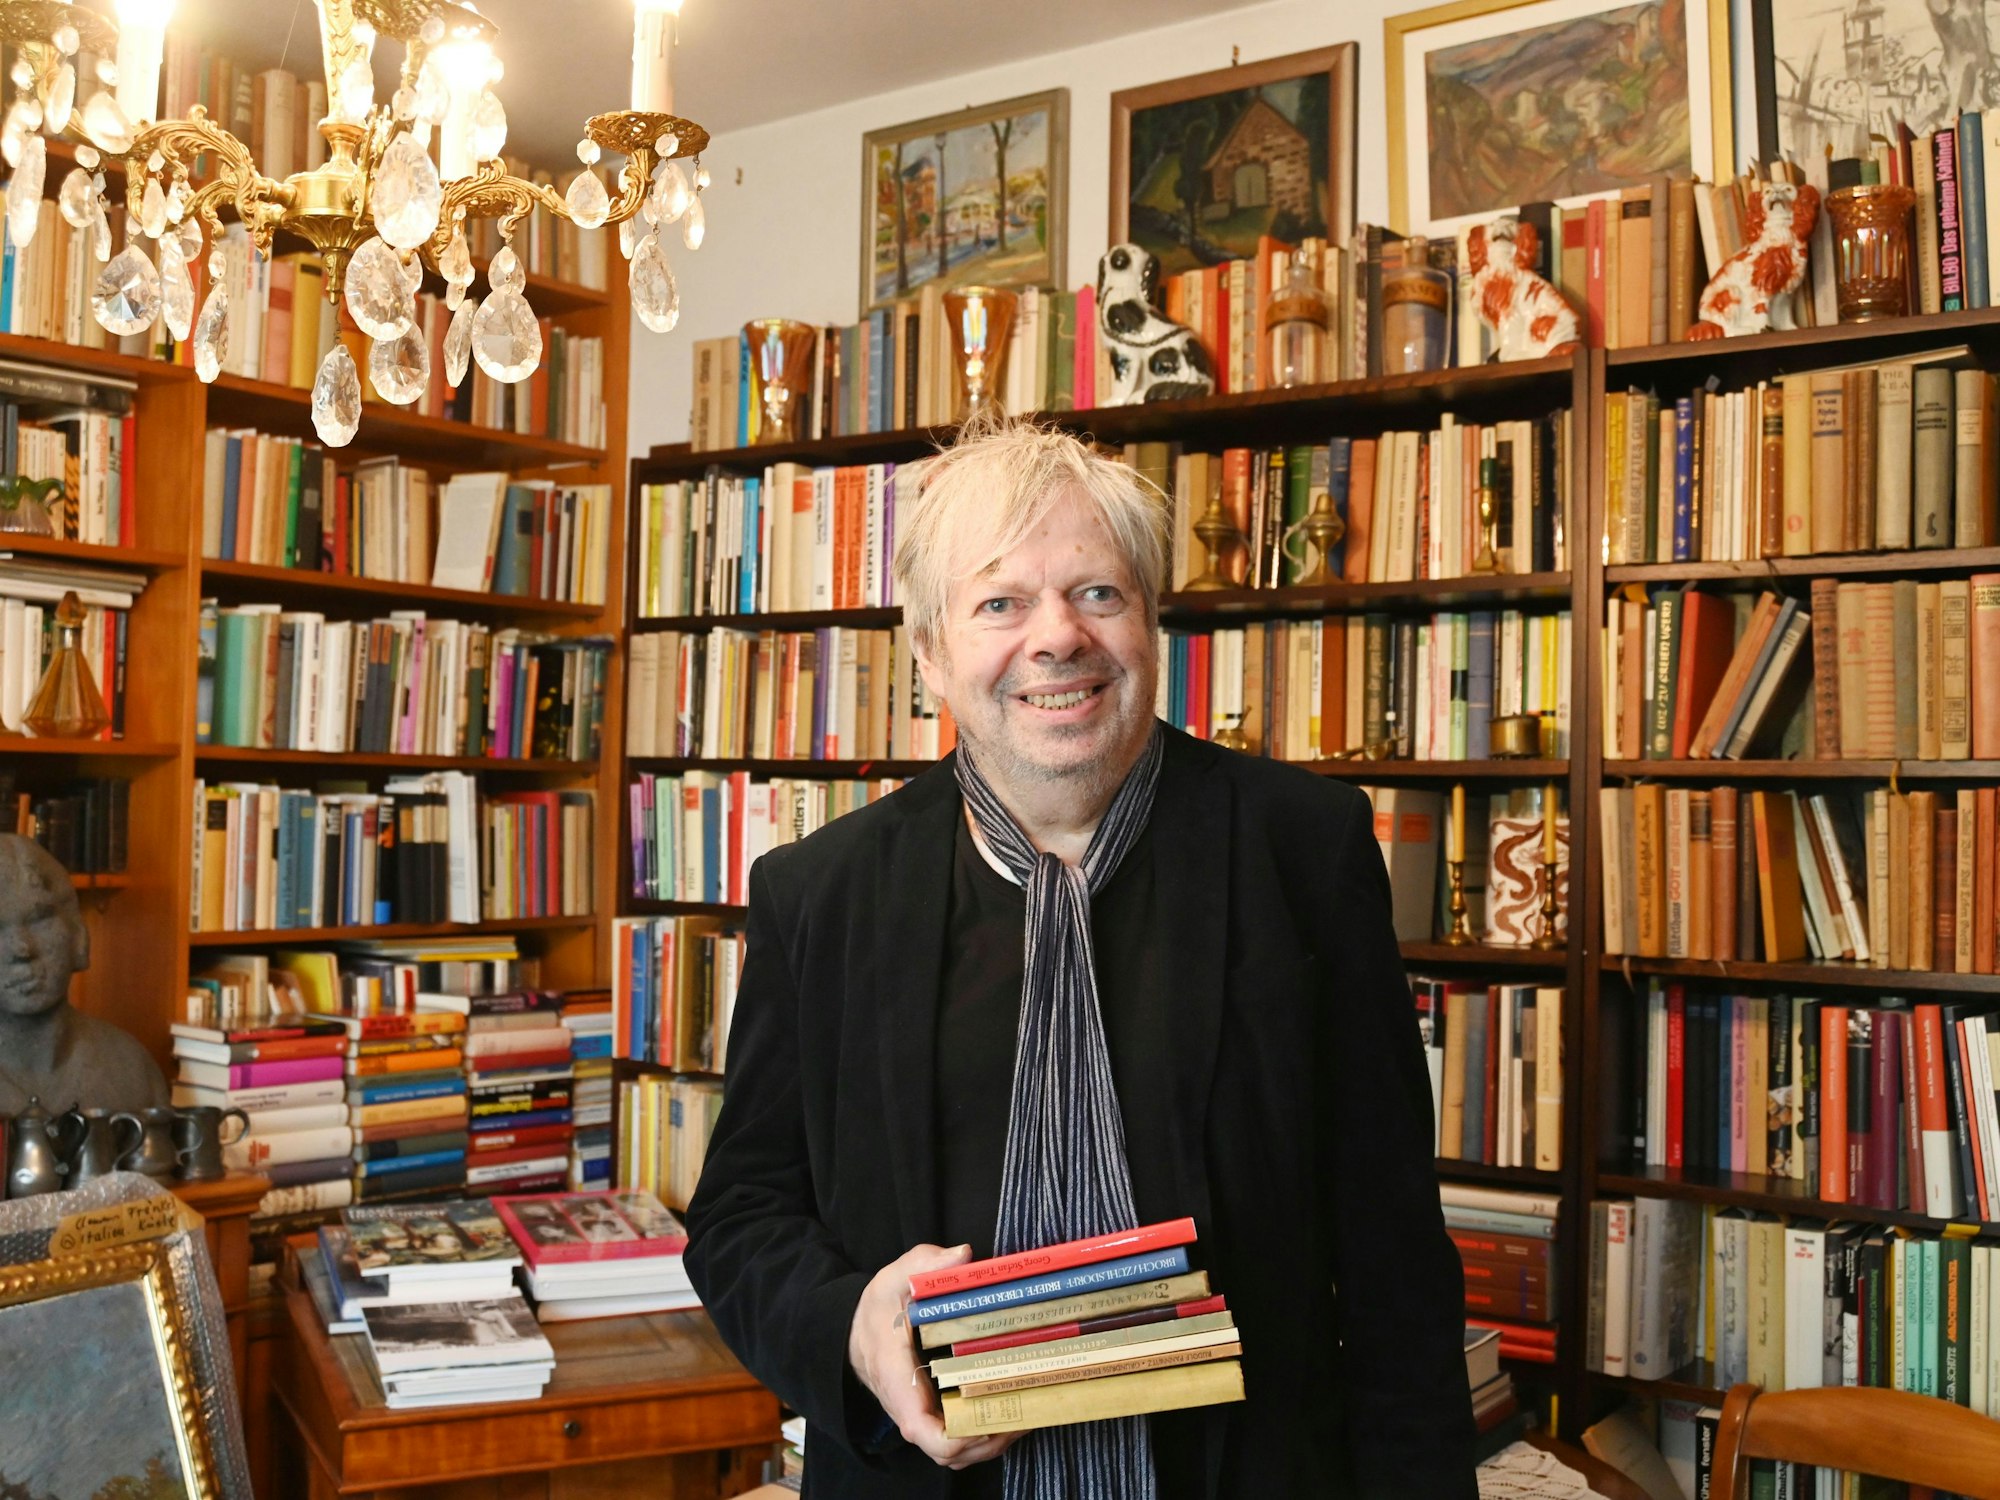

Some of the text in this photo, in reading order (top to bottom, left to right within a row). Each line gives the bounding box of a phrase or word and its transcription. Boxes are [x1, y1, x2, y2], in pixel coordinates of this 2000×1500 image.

[1935, 132, 1953, 181] Kabinett
[1939, 181, 1958, 229] geheime
[1941, 231, 1958, 253] Das
[1630, 444, 1642, 515] BESETZTES
[923, 1253, 1052, 1290] Georg Stefan Troller Santa Fe
[1024, 1279, 1062, 1297] BRIEFE
[917, 1293, 997, 1319] DEUTSCHLAND
[972, 1304, 1084, 1333] LIEBESGESCHICHTE
[1080, 1338, 1108, 1350] GRETE
[972, 1357, 994, 1368] WELT
[994, 1354, 1013, 1364] DER
[1013, 1350, 1038, 1361] ENDE
[1186, 1350, 1213, 1361] RUDOLF
[1946, 1346, 1957, 1381] SCHÜTZ
[957, 1373, 982, 1383] ERIKA
[983, 1368, 1010, 1380] MANN
[1016, 1365, 1034, 1374] DAS
[1040, 1370, 1081, 1384] GESCHICHTE
[1080, 1367, 1102, 1378] EINER
[1101, 1361, 1142, 1375] GRUNDRISS
[986, 1380, 1014, 1392] KULTUR
[1014, 1376, 1041, 1388] MEINER
[1701, 1424, 1711, 1466] fenster
